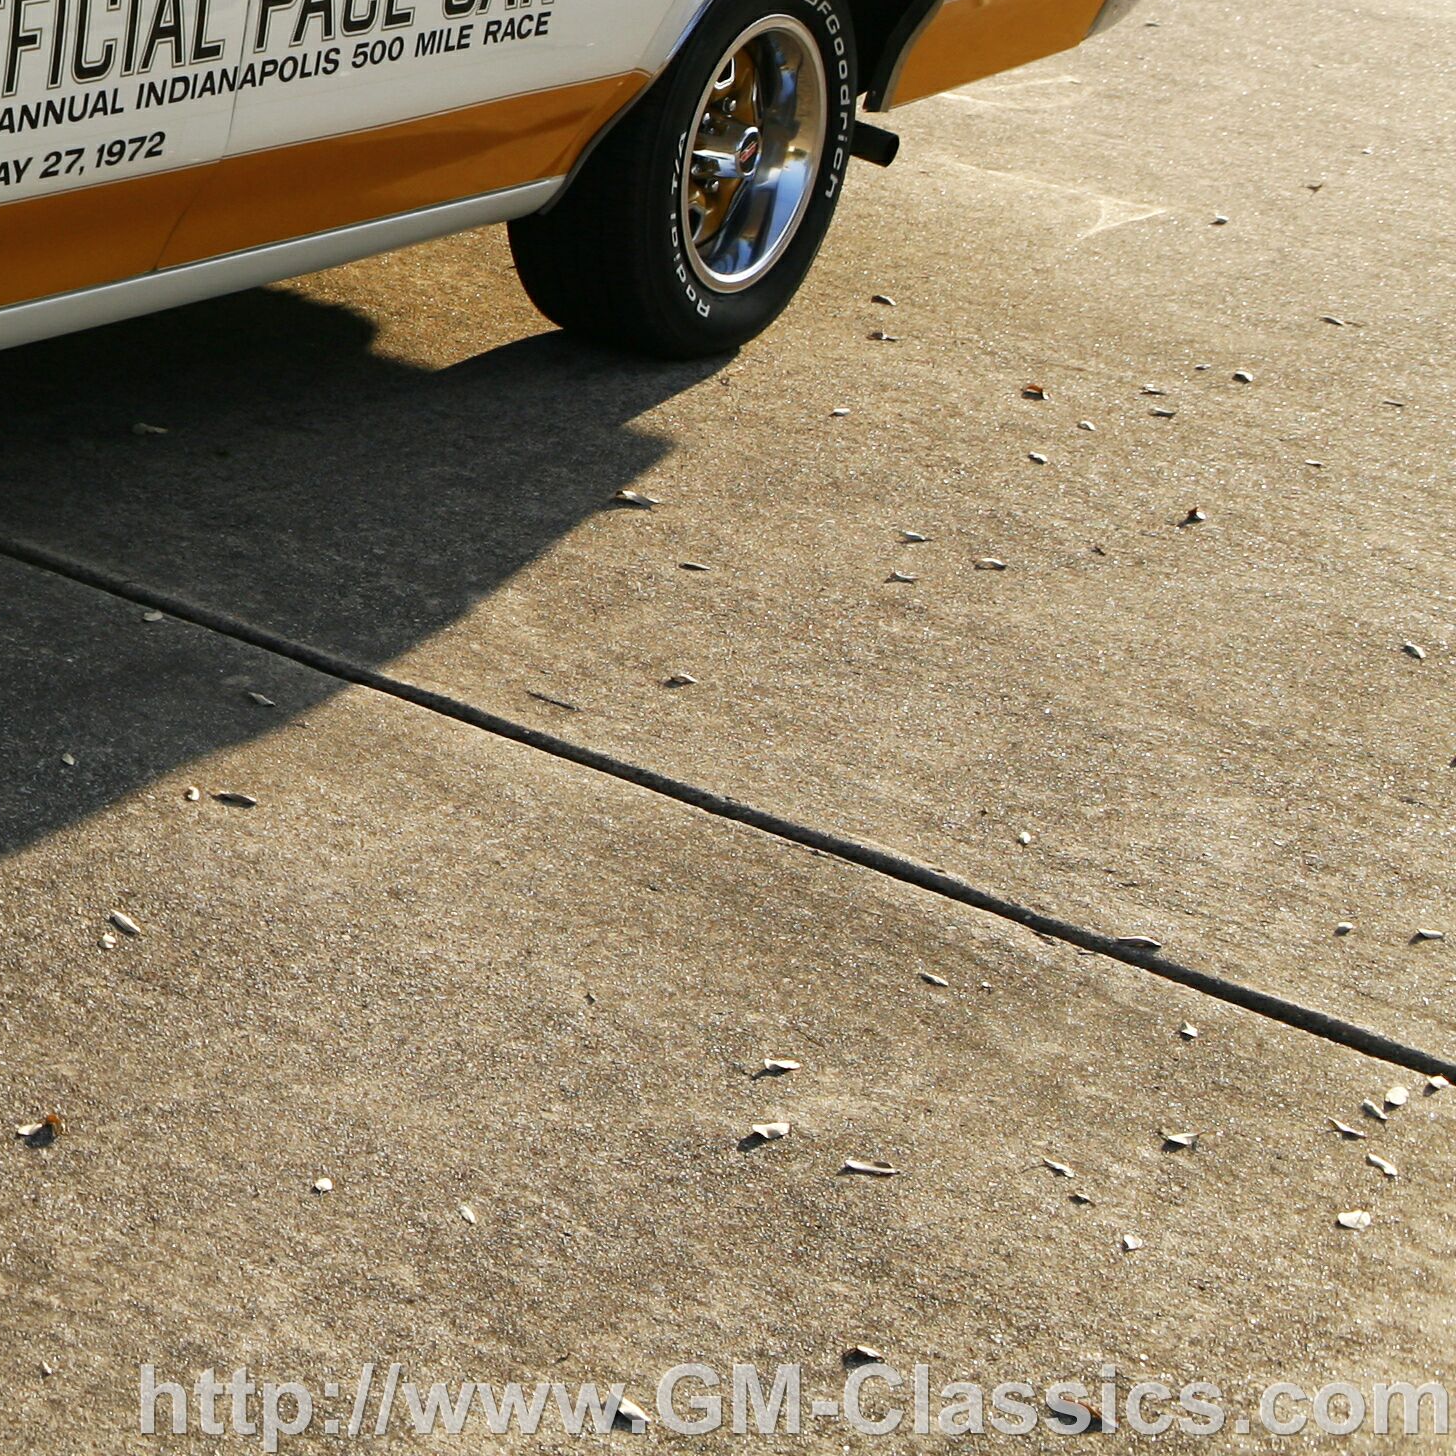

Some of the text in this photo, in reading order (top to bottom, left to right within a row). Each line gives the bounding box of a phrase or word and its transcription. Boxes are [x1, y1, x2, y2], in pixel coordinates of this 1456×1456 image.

[135, 47, 340, 110] INDIANAPOLIS
[351, 36, 404, 68] 500
[414, 24, 473, 57] MILE
[483, 11, 552, 45] RACE
[39, 148, 85, 179] 27,
[95, 131, 166, 169] 1972
